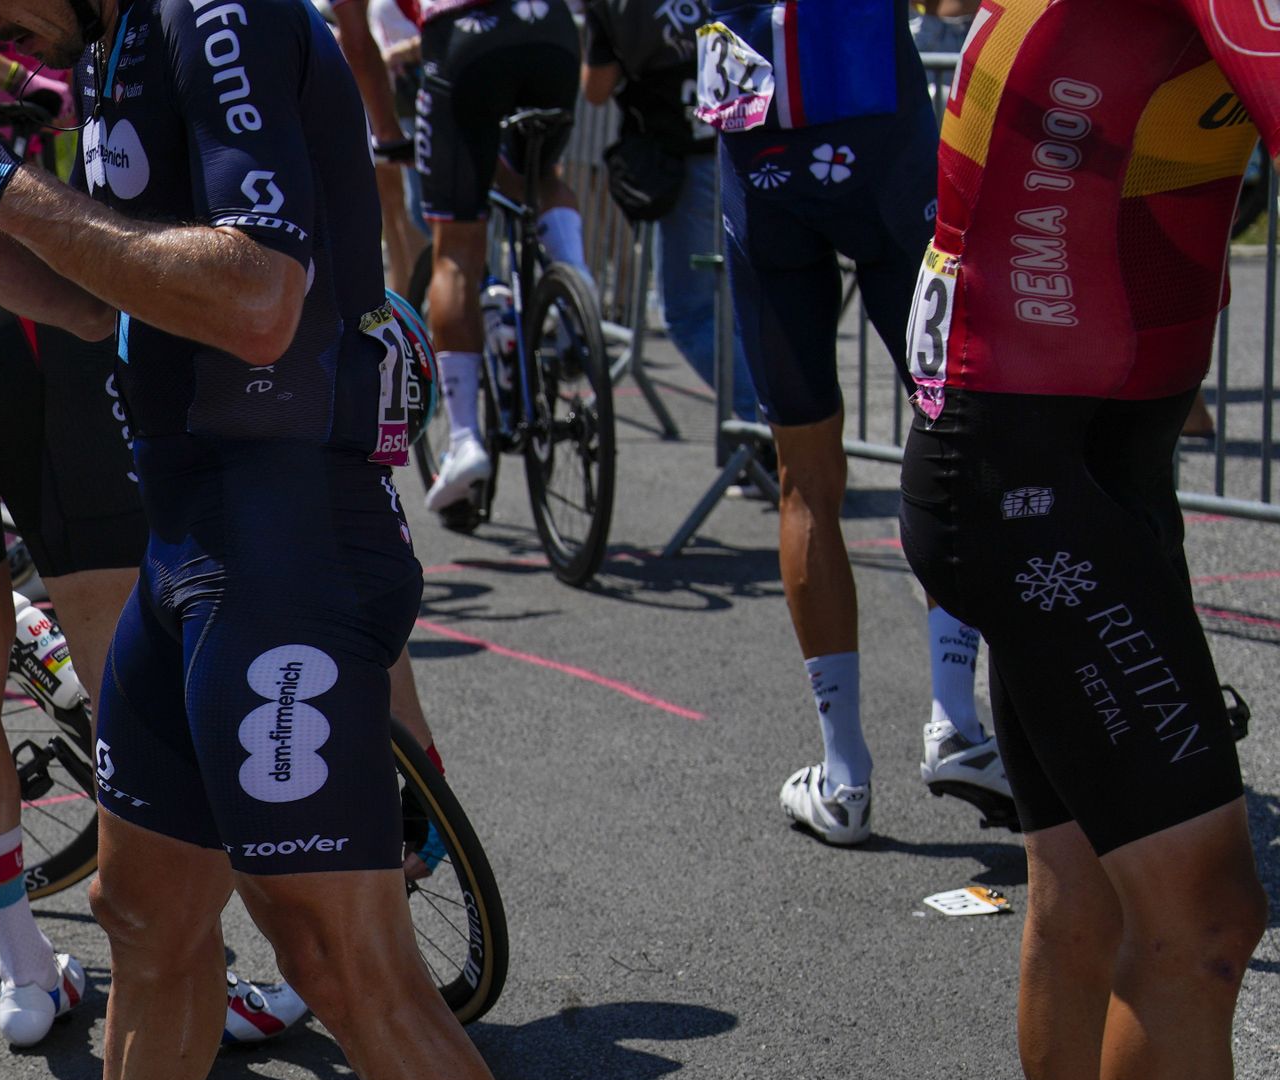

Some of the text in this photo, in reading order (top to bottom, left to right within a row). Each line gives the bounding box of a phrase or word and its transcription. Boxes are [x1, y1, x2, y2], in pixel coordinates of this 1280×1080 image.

[214, 213, 308, 241] SCOTT
[1010, 77, 1104, 328] REMA 1000
[268, 661, 303, 783] dsm-firmenich
[1075, 663, 1133, 747] RETAIL
[1086, 603, 1210, 764] REITAN
[242, 834, 350, 858] zoover
